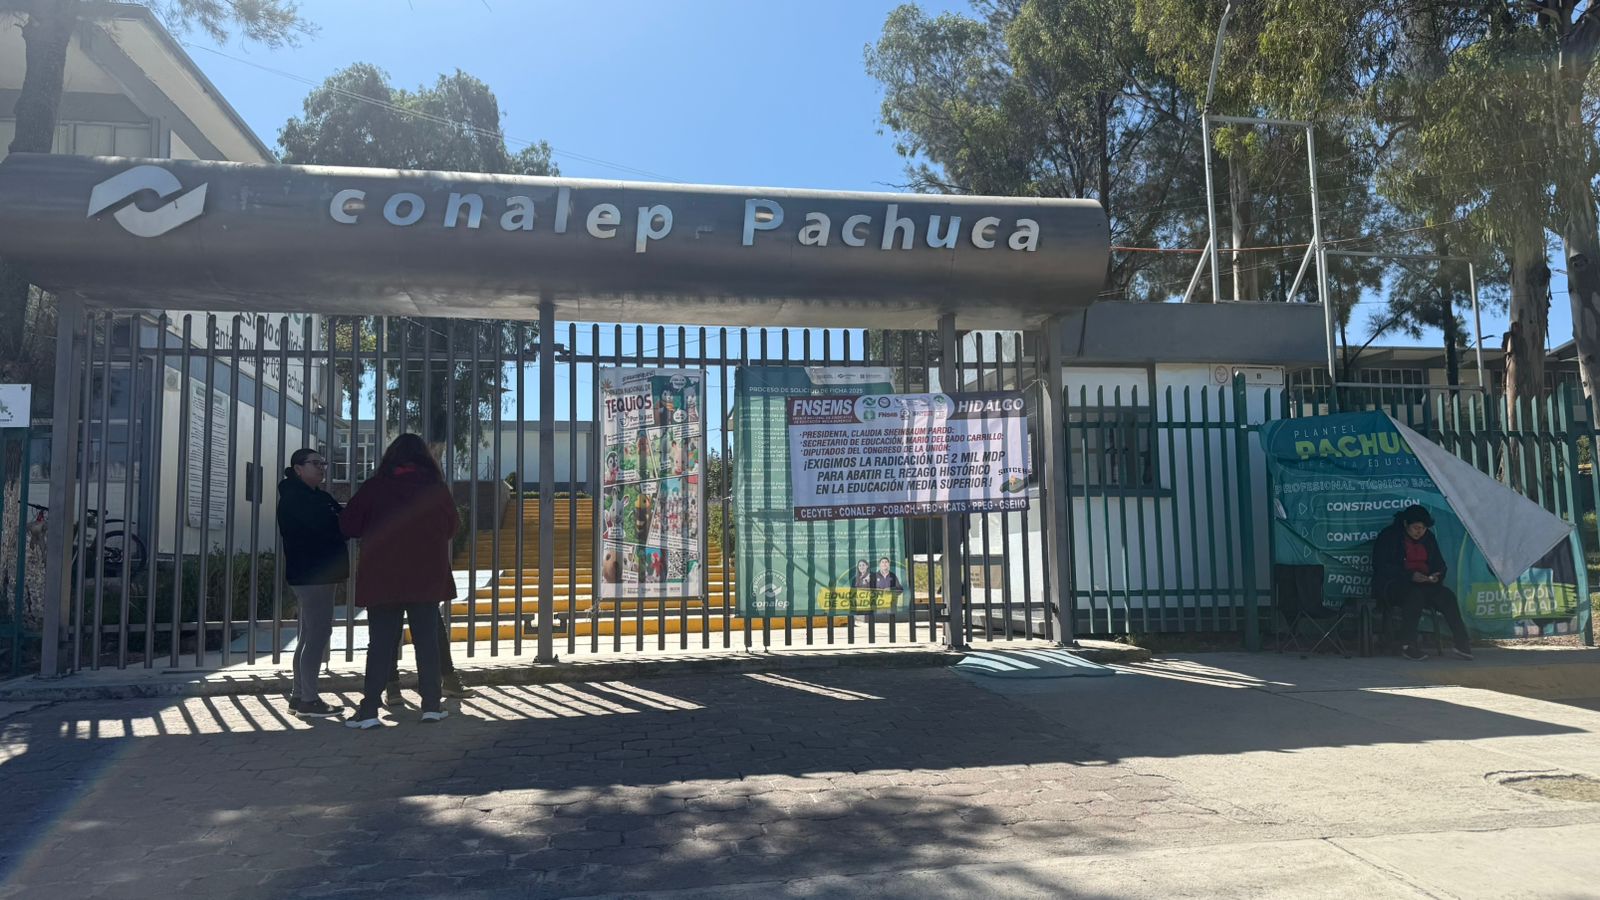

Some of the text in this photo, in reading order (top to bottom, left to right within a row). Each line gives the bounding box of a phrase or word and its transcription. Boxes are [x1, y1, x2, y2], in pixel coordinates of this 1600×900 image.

[329, 186, 1040, 253] conalep Pachuca
[793, 399, 852, 417] FNSEMS
[958, 397, 1024, 413] HIDALGO
[802, 426, 955, 439] PRESIDENTA, CLAUDIA SHEINBAUM PARDO:
[802, 432, 1004, 448] SECRETARIO DE EDUCACIÓN, MARIO DELGADO CARRILLO:
[1294, 425, 1357, 439] PLANTEL
[803, 447, 845, 457] DIPUTADOS
[847, 446, 861, 455] DEL
[863, 445, 901, 455] CONGRESO
[903, 445, 914, 453] DE
[914, 444, 924, 453] LA
[804, 451, 1006, 471] ¡EXIGIMOS LA RADICACIÓN DE 2 MIL MDP
[817, 463, 991, 481] PARA ABATIR EL REZAGO HISTÓRICO
[816, 477, 993, 495] EN LA EDUCACIÓN MEDIA SUPERIOR!
[1275, 480, 1356, 494] PROFESIONAL
[800, 508, 832, 518] CECYTE
[839, 506, 877, 517] CONALEP
[882, 504, 914, 515] COBACH
[922, 503, 938, 513] TBC
[943, 502, 966, 512] ICATS
[972, 500, 993, 510] PPEG
[1327, 496, 1420, 512] CONSTRUCCIÓN
[751, 598, 790, 609] conalep
[823, 599, 885, 609] DE CALIDAD
[1475, 604, 1496, 616] DE
